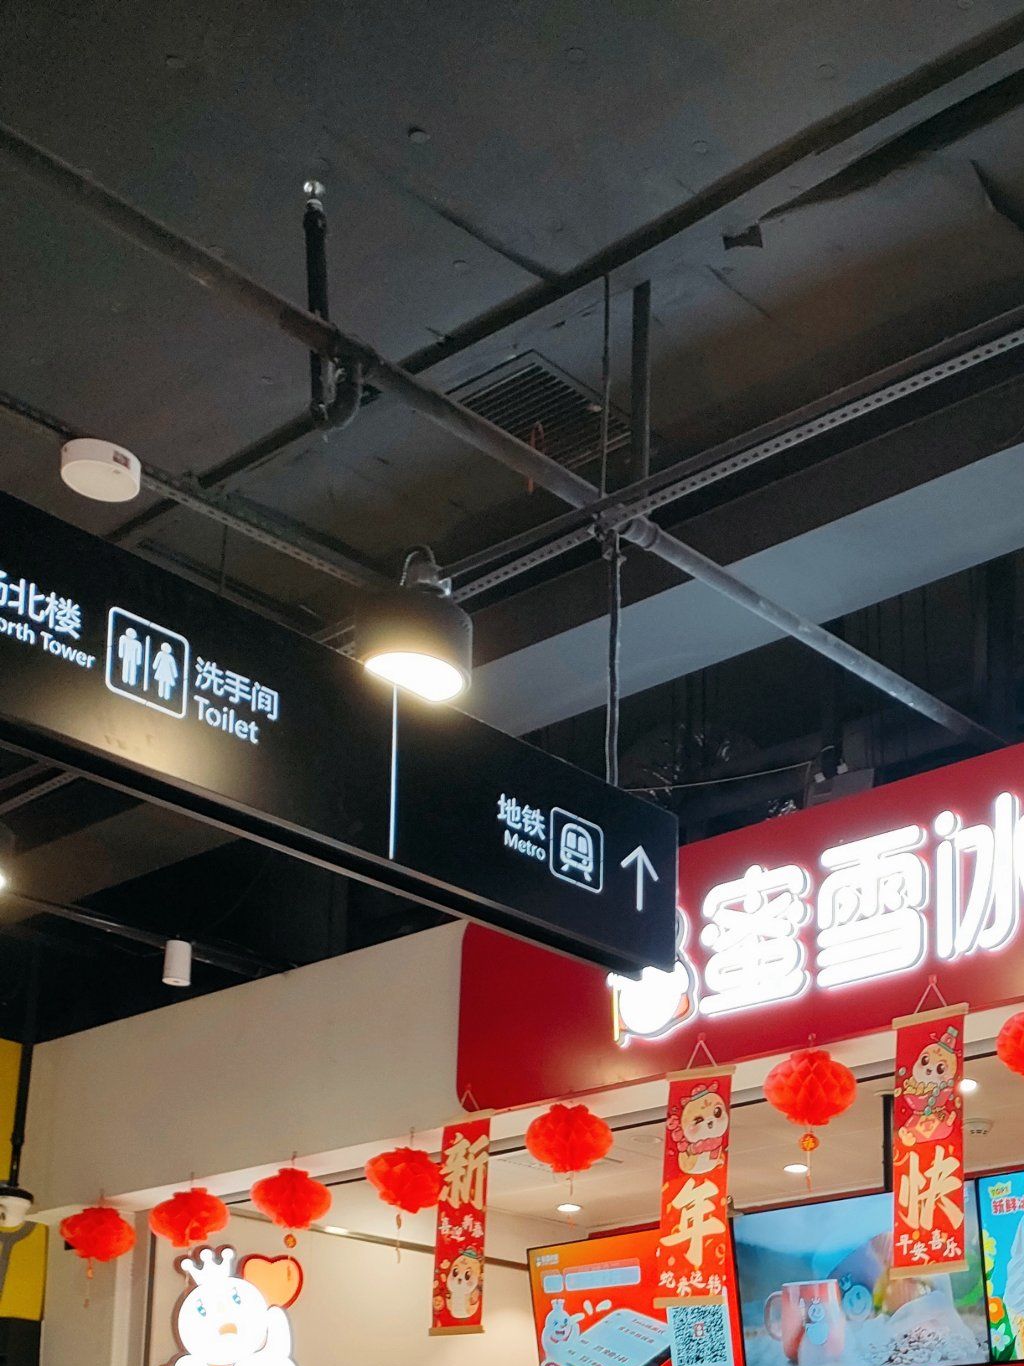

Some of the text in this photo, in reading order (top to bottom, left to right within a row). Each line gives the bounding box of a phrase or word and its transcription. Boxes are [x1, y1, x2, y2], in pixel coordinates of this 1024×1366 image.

[0, 617, 96, 668] orth Tower
[195, 656, 279, 721] 洗手间
[194, 696, 259, 744] Toilet
[497, 794, 548, 840] 地铁
[503, 830, 547, 861] Metro
[439, 1132, 489, 1211] 新
[898, 1145, 964, 1231] 快
[659, 1177, 726, 1267] 年
[895, 1229, 962, 1260] 平安喜乐
